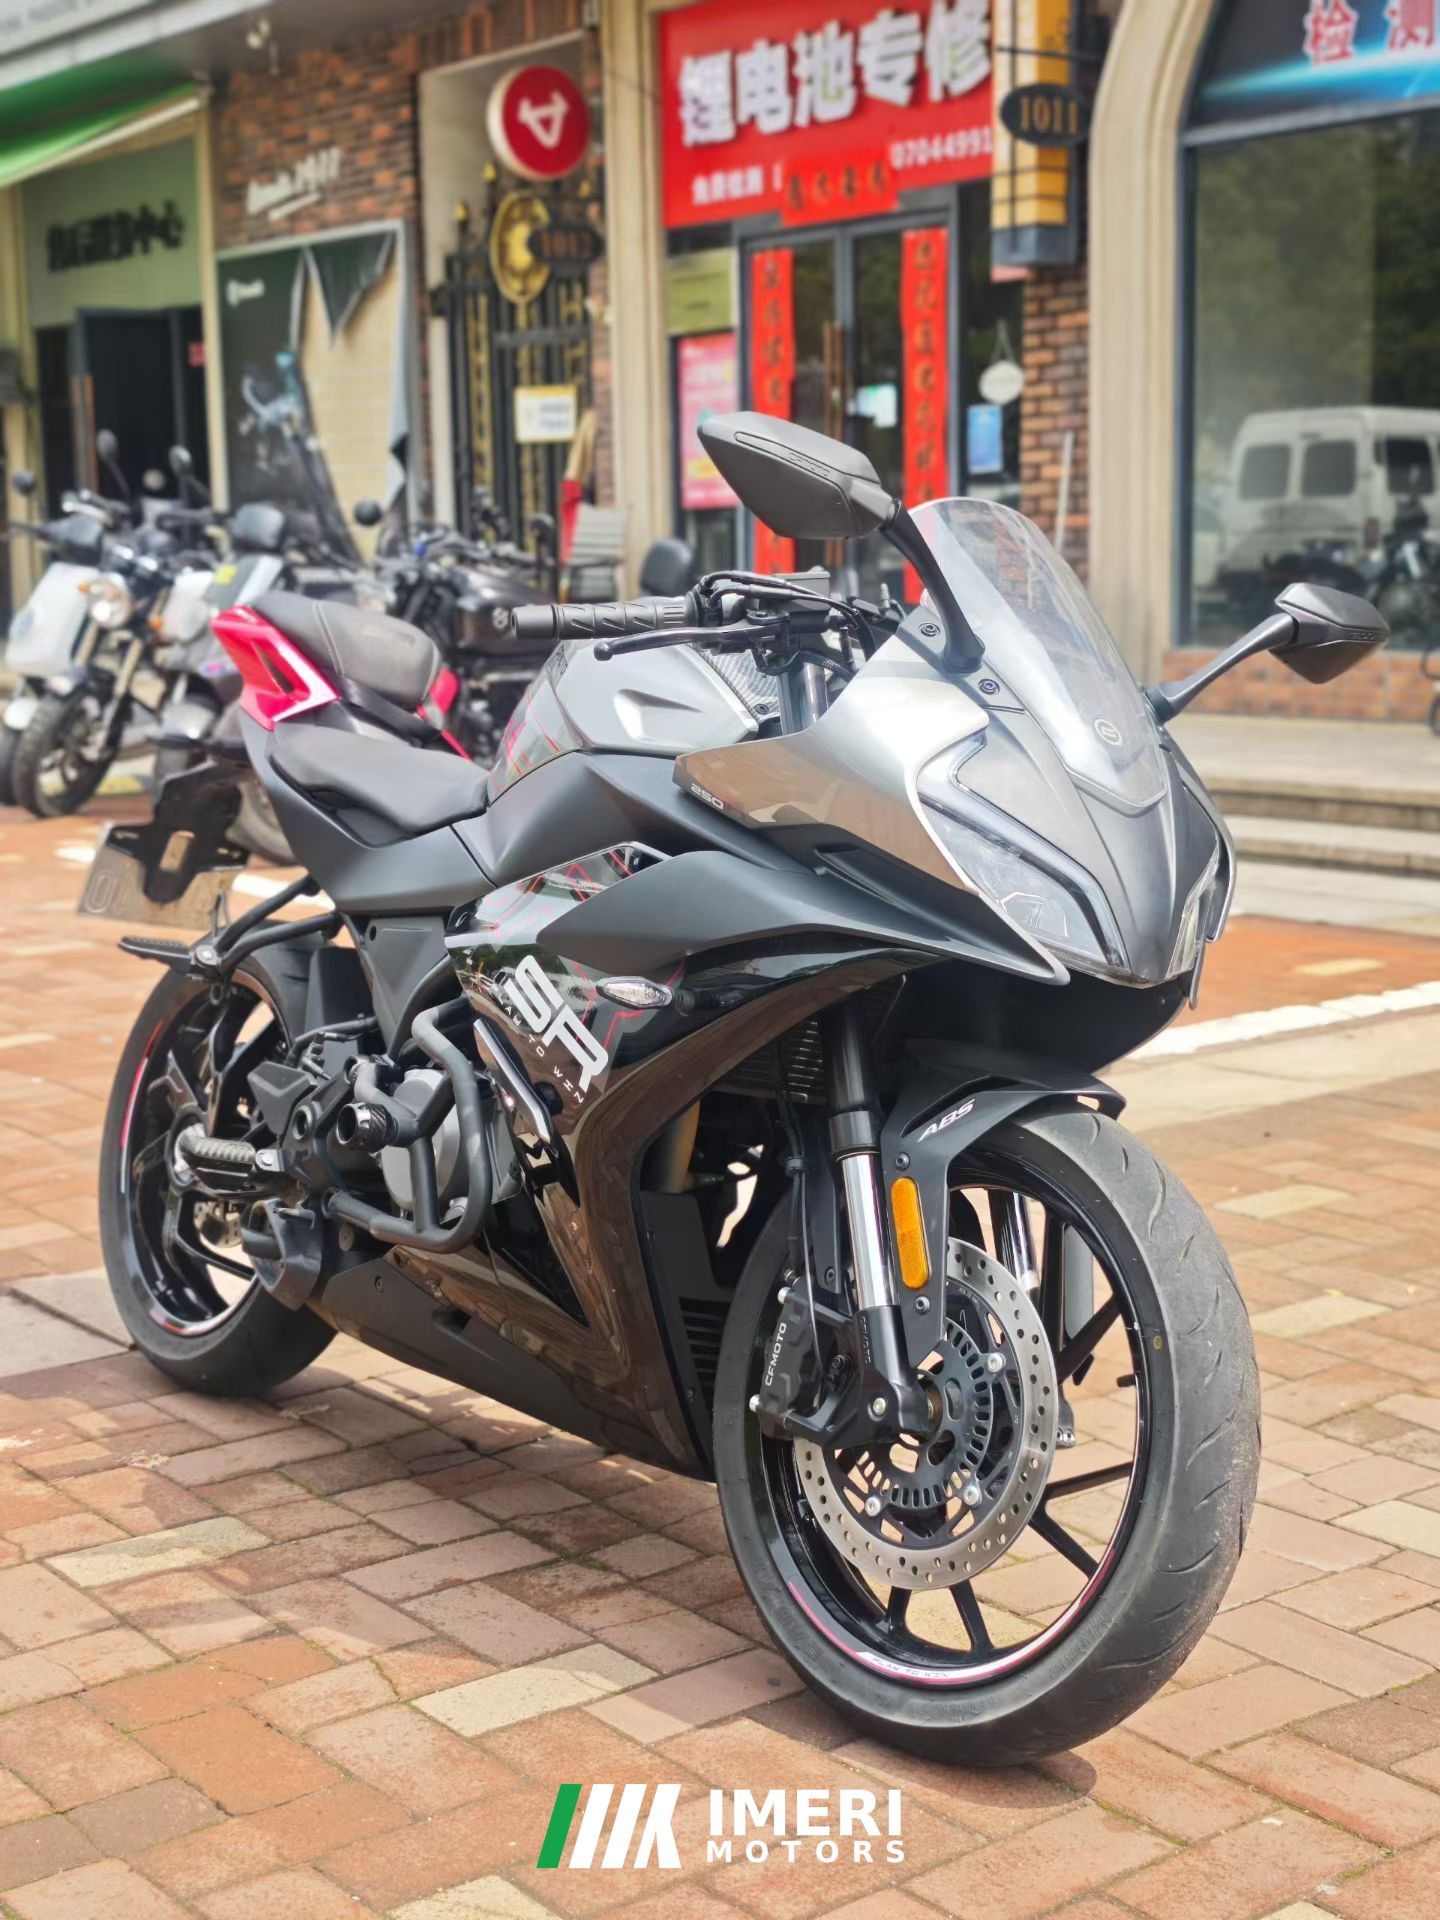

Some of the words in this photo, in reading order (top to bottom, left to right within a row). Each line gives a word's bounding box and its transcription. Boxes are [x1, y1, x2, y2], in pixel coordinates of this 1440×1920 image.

[1020, 95, 1079, 136] 1011
[690, 782, 724, 810] 250
[503, 954, 609, 1094] SR
[528, 1033, 546, 1058] TO
[553, 1064, 585, 1104] WIN
[916, 1097, 977, 1143] ABS
[764, 1322, 788, 1387] CFMOTO
